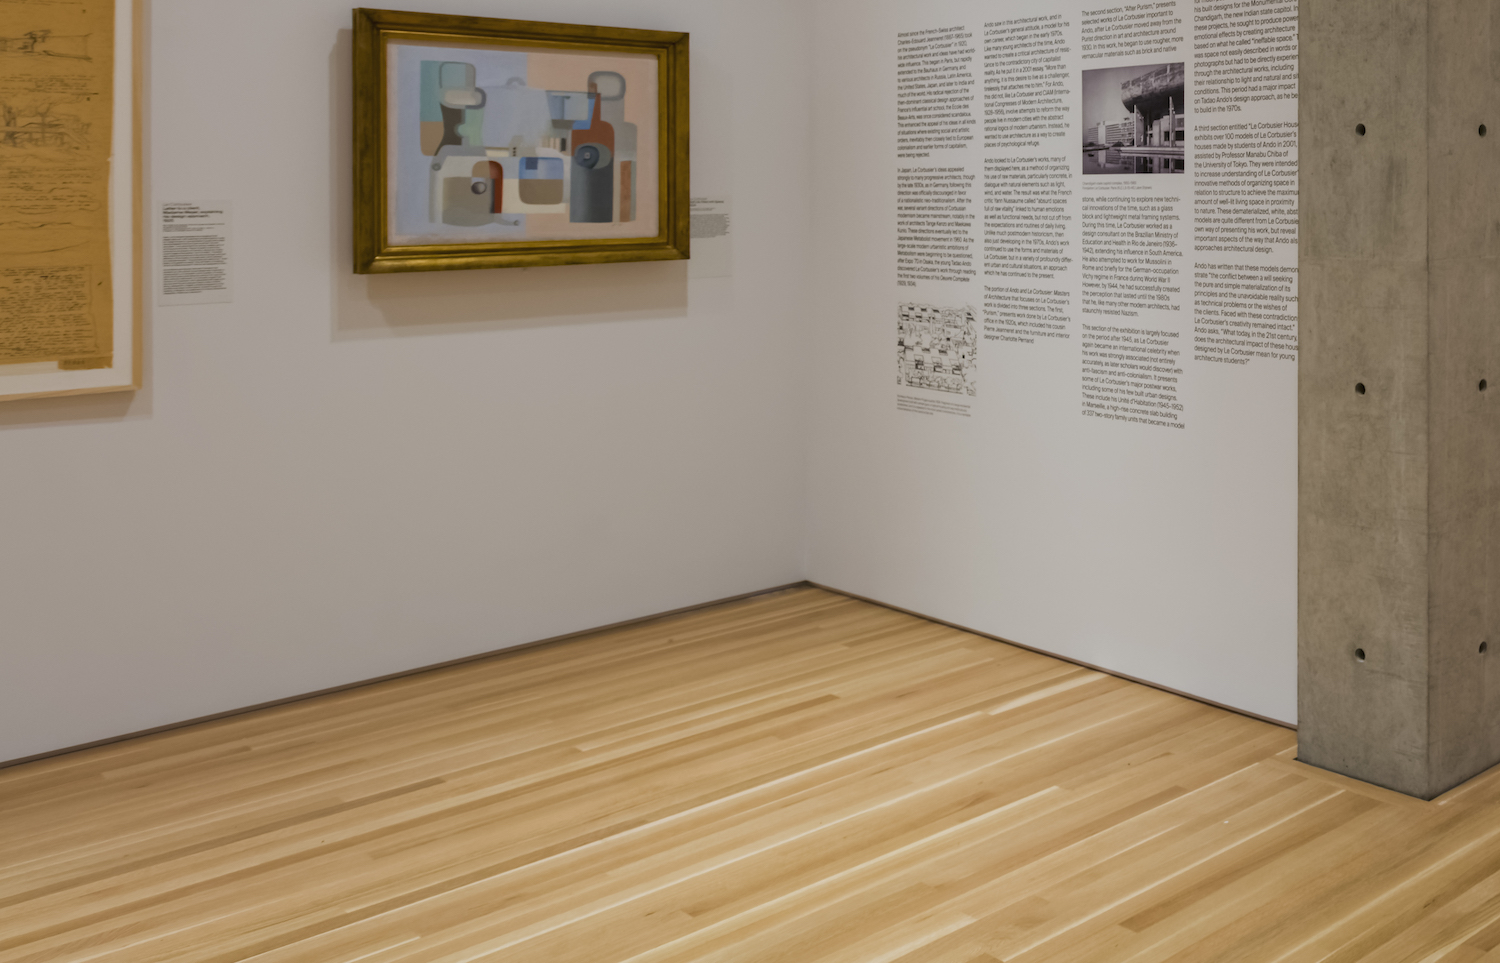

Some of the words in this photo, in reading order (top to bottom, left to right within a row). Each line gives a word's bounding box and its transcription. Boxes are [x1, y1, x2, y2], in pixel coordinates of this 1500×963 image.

[1202, 4, 1213, 12] built
[1213, 2, 1233, 12] designs
[1233, 1, 1241, 9] for
[1241, 0, 1250, 8] the
[1194, 31, 1219, 40] emotional
[1218, 30, 1236, 38] effects
[1236, 29, 1243, 38] by
[1242, 27, 1264, 37] creating
[1264, 24, 1296, 34] architecture
[1194, 69, 1213, 78] through
[1222, 66, 1254, 75] architectural
[1270, 63, 1295, 73] including
[1231, 85, 1248, 94] period
[1262, 83, 1277, 92] major
[1278, 82, 1296, 91] impact
[1215, 152, 1221, 160] by
[1246, 179, 1273, 187] organizing
[1235, 199, 1248, 207] living
[1270, 199, 1295, 207] proximity
[1194, 244, 1223, 252] approaches
[1237, 273, 1260, 281] between
[1272, 274, 1294, 284] seeking
[1224, 282, 1241, 291] simple
[1240, 283, 1278, 291] materialization
[1228, 319, 1252, 329] creativity
[1251, 321, 1277, 330] remained
[1194, 344, 1217, 354] designed
[1216, 346, 1223, 355] by
[1230, 348, 1255, 357] Corbusier
[1270, 351, 1278, 359] for
[1279, 353, 1296, 362] young
[1194, 353, 1223, 363] architecture
